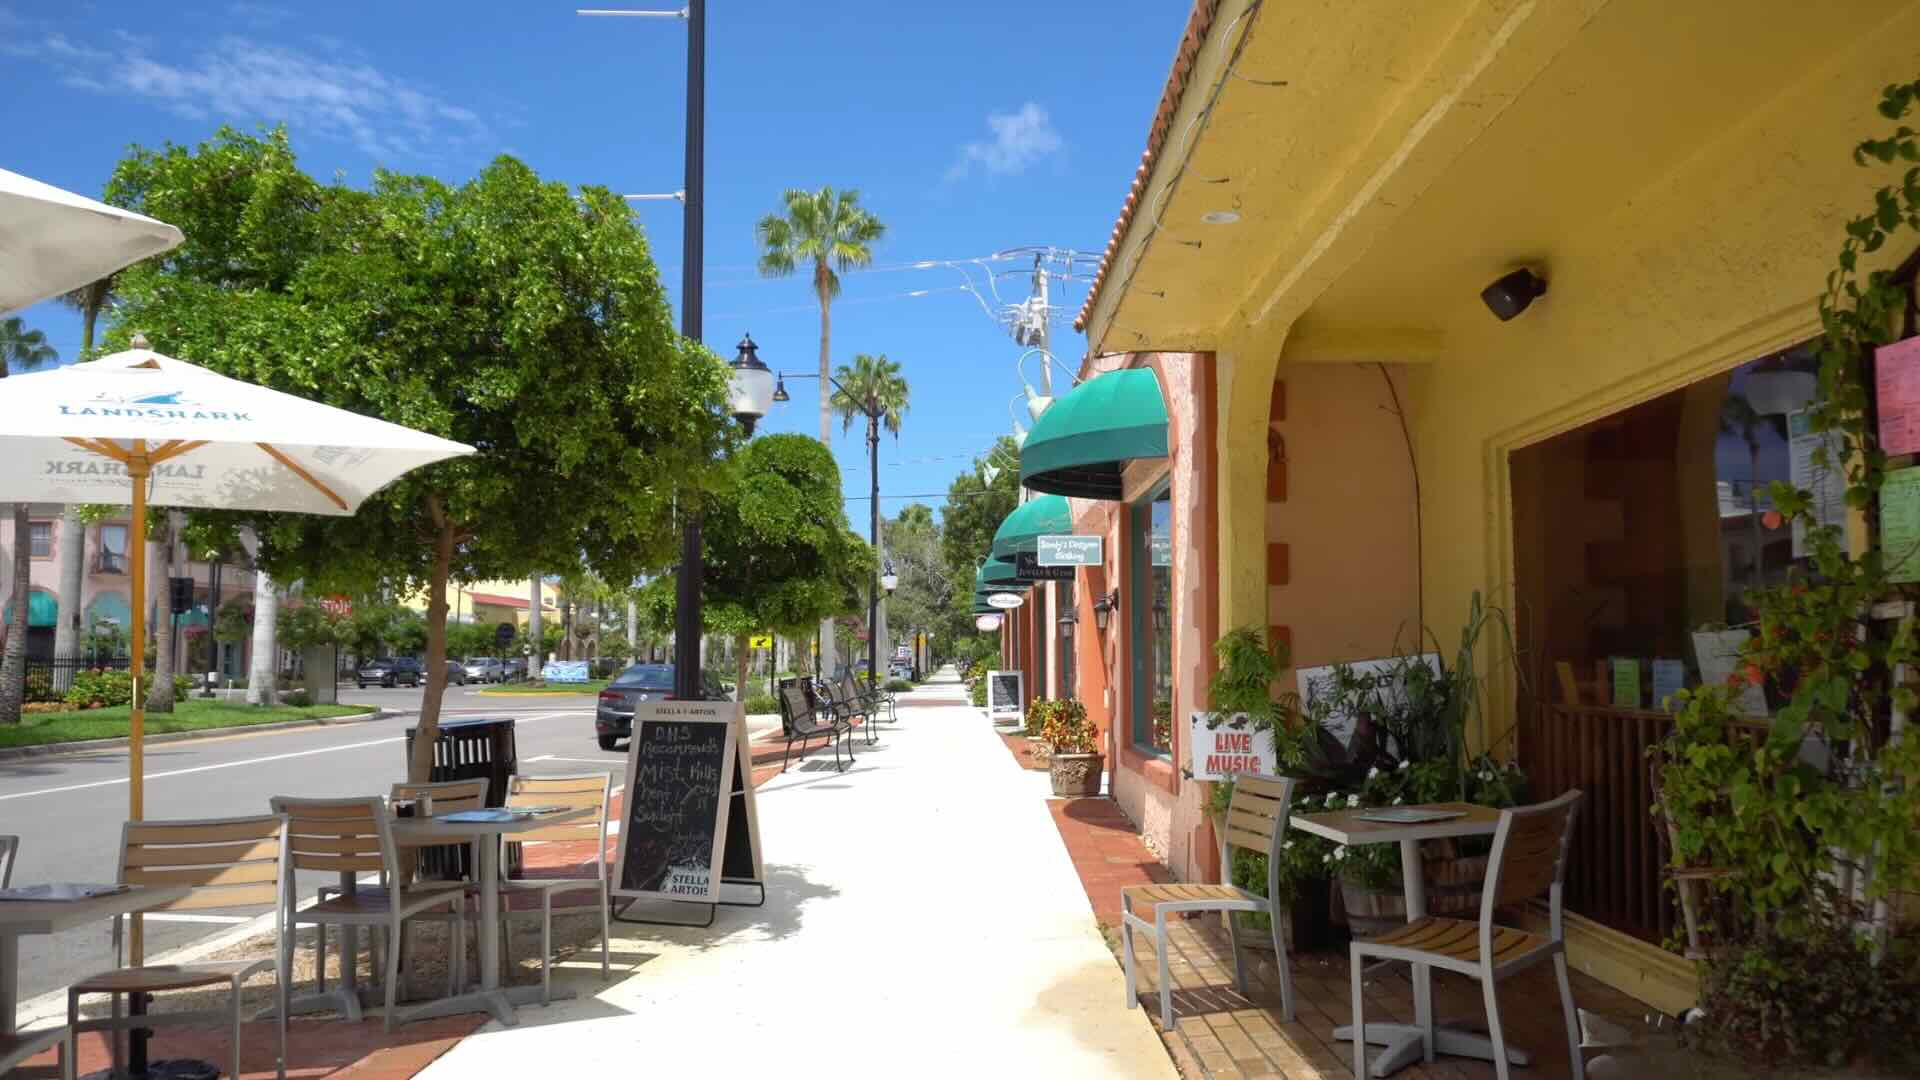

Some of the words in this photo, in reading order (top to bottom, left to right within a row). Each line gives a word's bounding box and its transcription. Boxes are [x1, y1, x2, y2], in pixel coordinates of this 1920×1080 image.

[57, 404, 253, 421] LANDSHARK
[656, 707, 681, 715] STELLA
[690, 708, 716, 716] ARTOIS
[1216, 733, 1252, 753] LIVE
[1206, 755, 1261, 775] MUSIC
[672, 874, 710, 886] STELLA
[670, 885, 709, 897] ARTOIS
